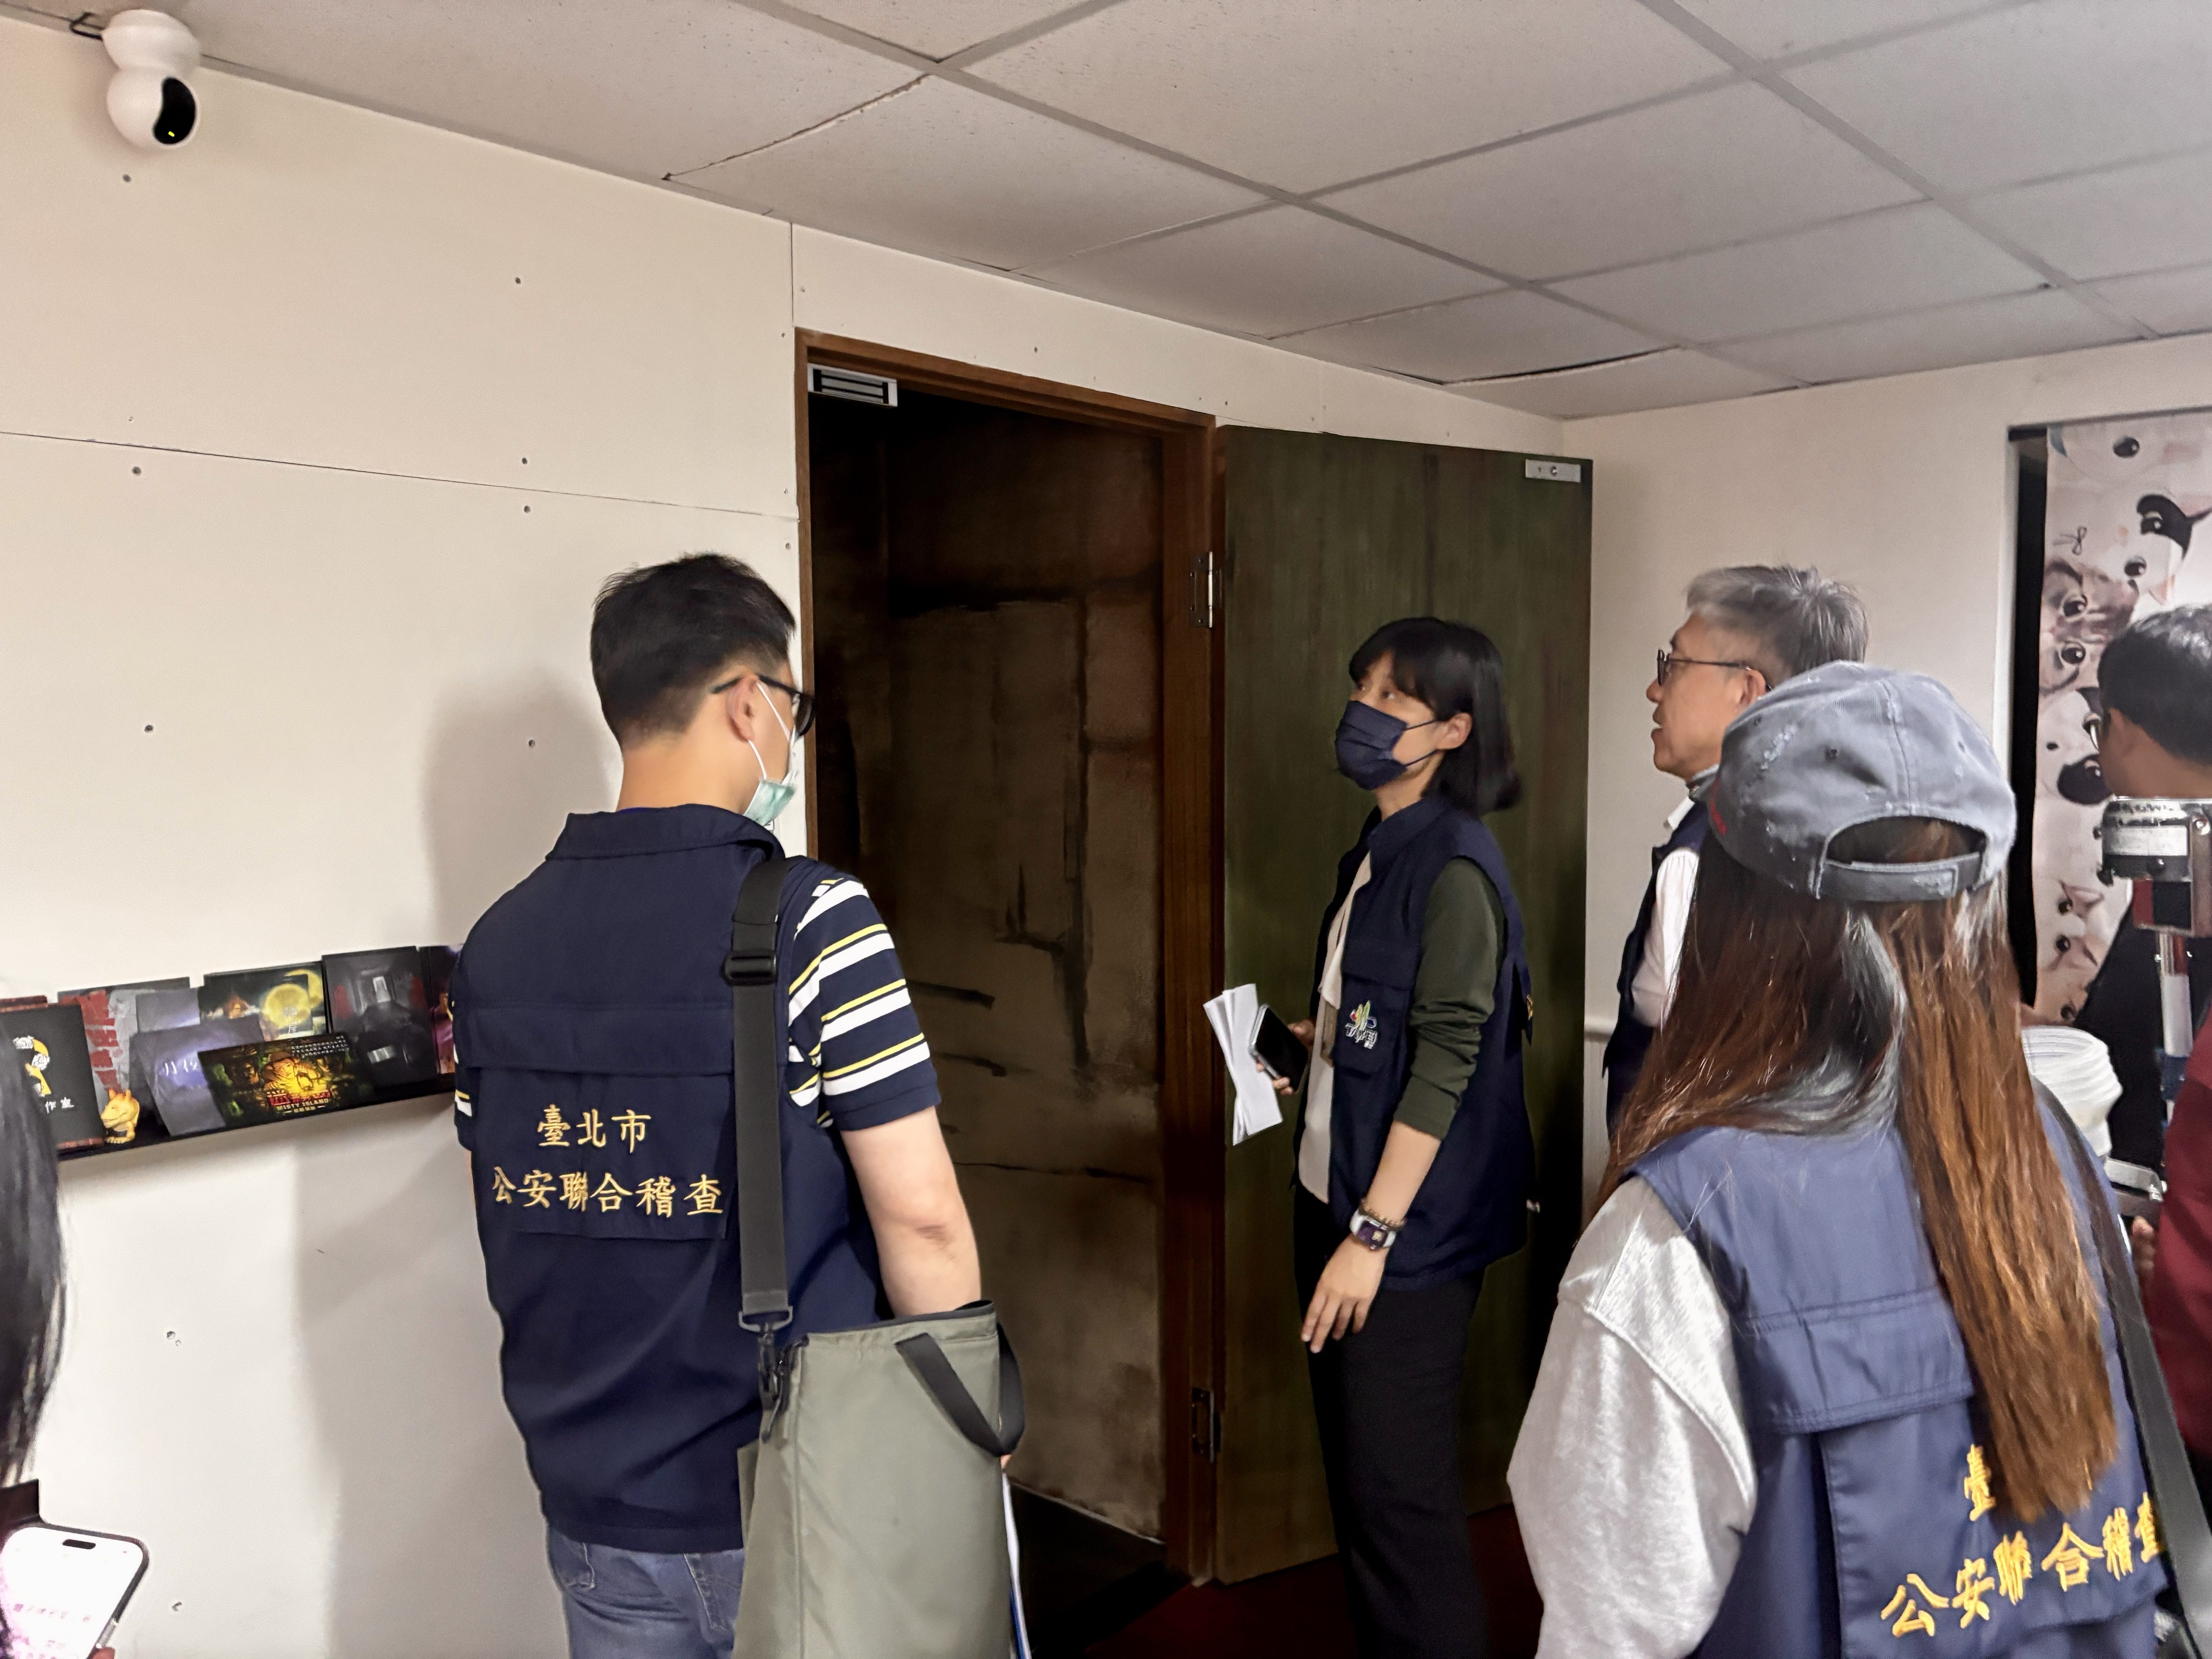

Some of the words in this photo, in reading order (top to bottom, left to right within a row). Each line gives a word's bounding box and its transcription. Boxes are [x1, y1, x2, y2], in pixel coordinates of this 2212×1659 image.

[537, 1104, 651, 1153] 臺北市
[492, 1166, 723, 1218] 公安聯合稽查
